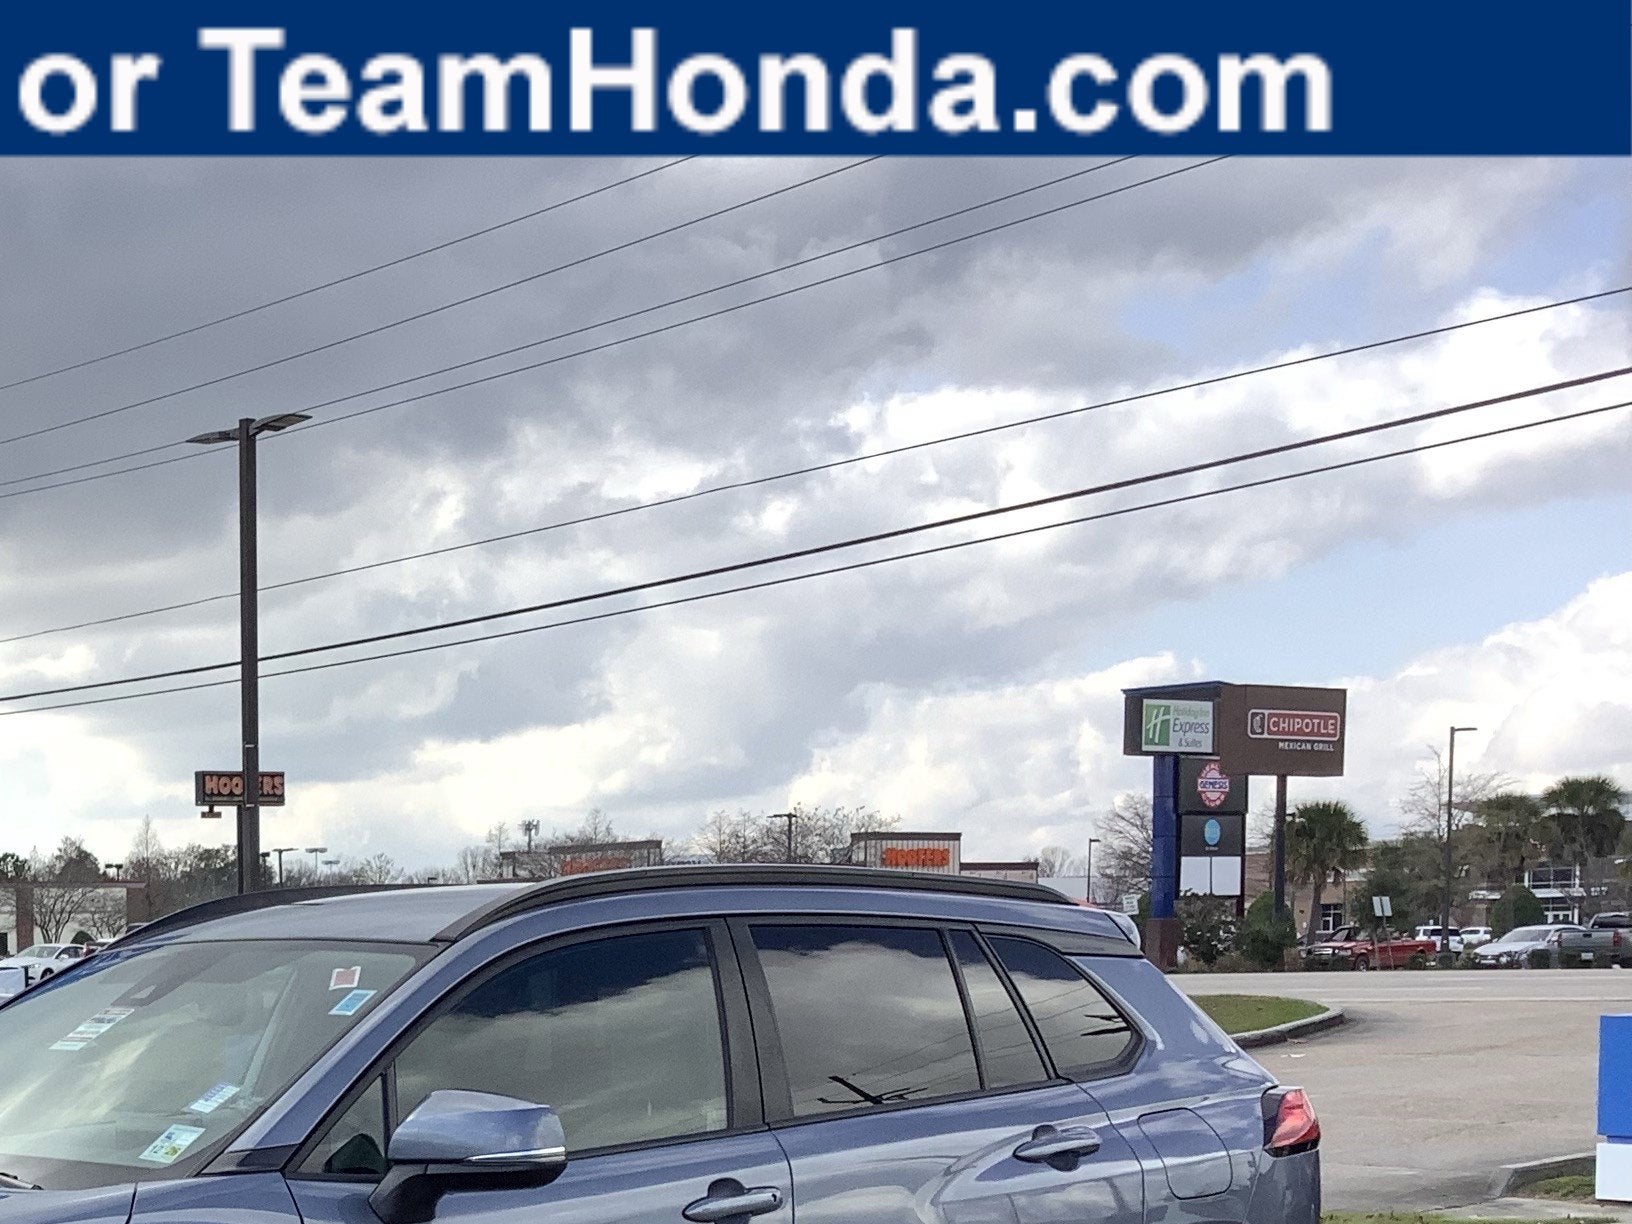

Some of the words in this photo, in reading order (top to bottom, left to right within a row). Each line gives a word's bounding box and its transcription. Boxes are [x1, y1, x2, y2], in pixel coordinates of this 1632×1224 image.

[1172, 717, 1210, 736] Express
[1269, 716, 1336, 735] CHIPOTLE
[1279, 741, 1312, 751] MEXICAN
[1313, 742, 1335, 752] GRILL
